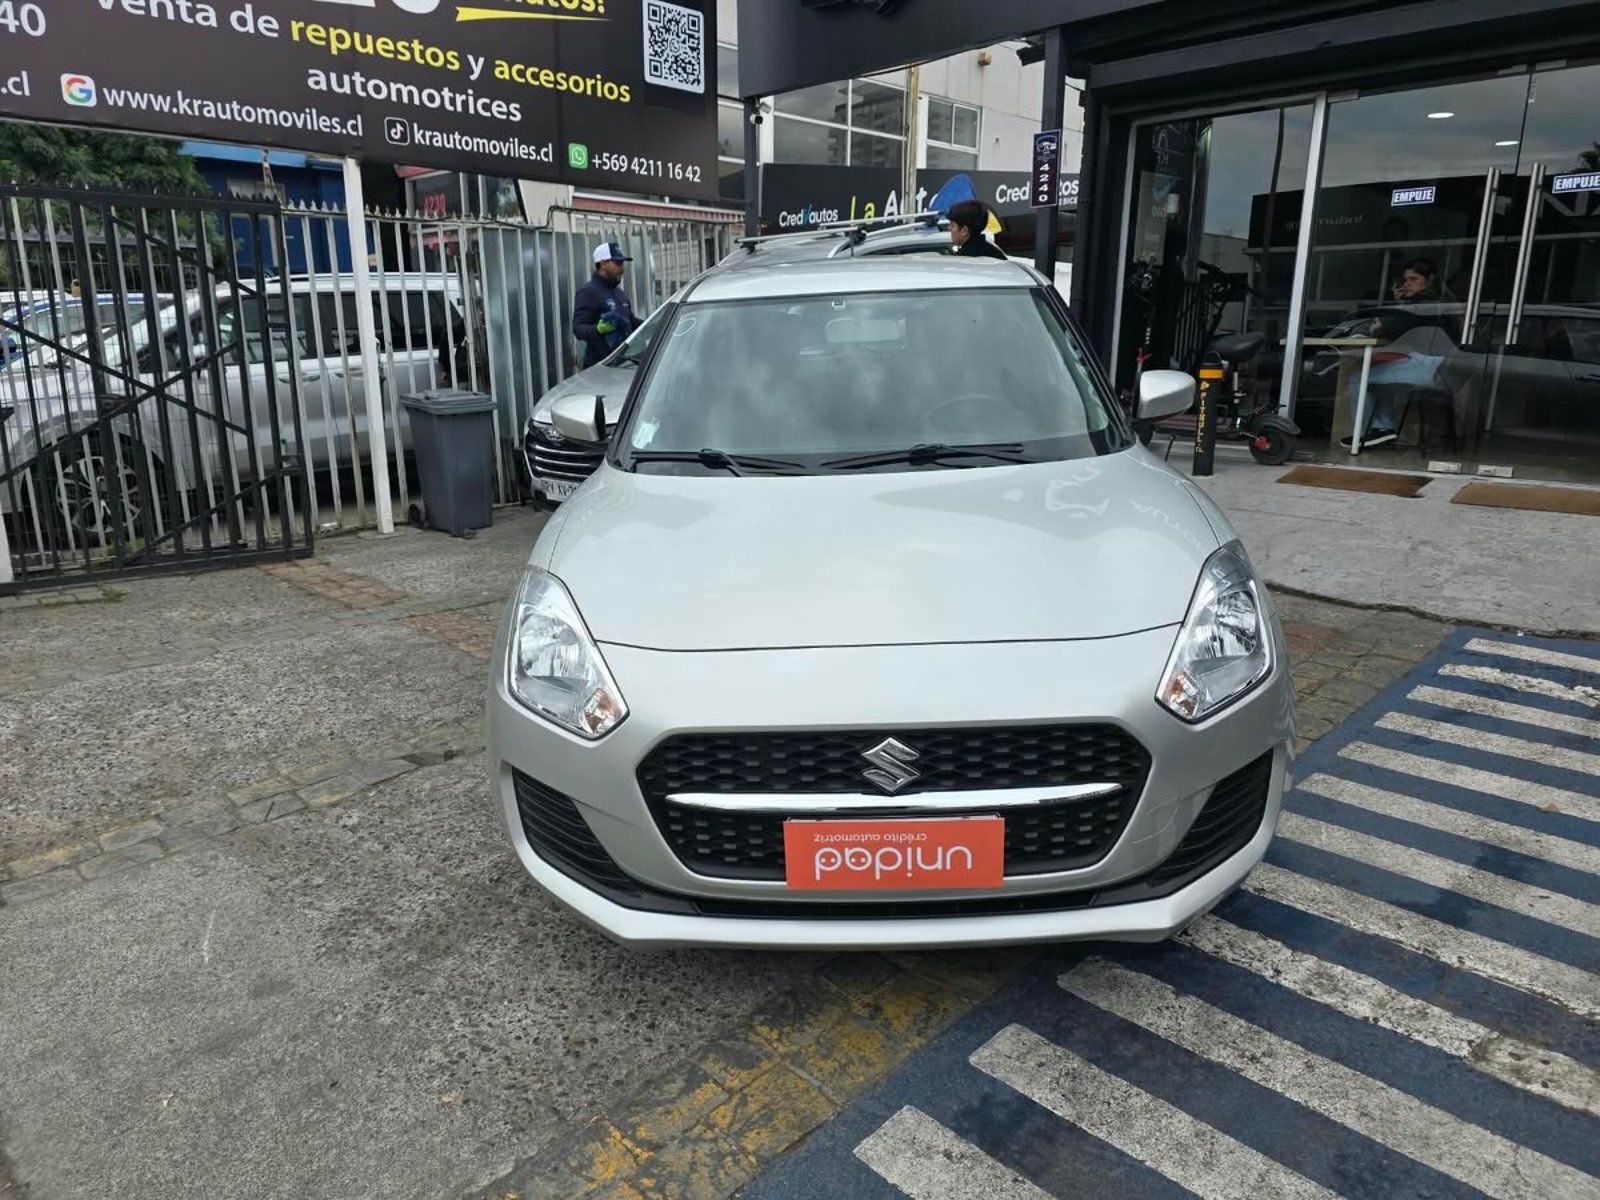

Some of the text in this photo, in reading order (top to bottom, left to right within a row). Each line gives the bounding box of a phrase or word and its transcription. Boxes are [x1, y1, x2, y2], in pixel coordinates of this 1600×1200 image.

[230, 3, 280, 38] de
[290, 19, 461, 71] repuestos
[467, 53, 486, 82] y
[493, 59, 632, 104] accesorios
[102, 87, 364, 137] www.krautomoviles.cl
[307, 68, 522, 122] automotrices
[413, 122, 553, 163] krautomoviles.cl
[591, 153, 701, 183] +569 4211 16 42
[1038, 163, 1050, 202] 4240
[1555, 175, 1600, 190] EMPUJE
[1394, 189, 1433, 203] EMPUJE
[813, 832, 881, 843] automotriz
[814, 845, 973, 881] unidad
